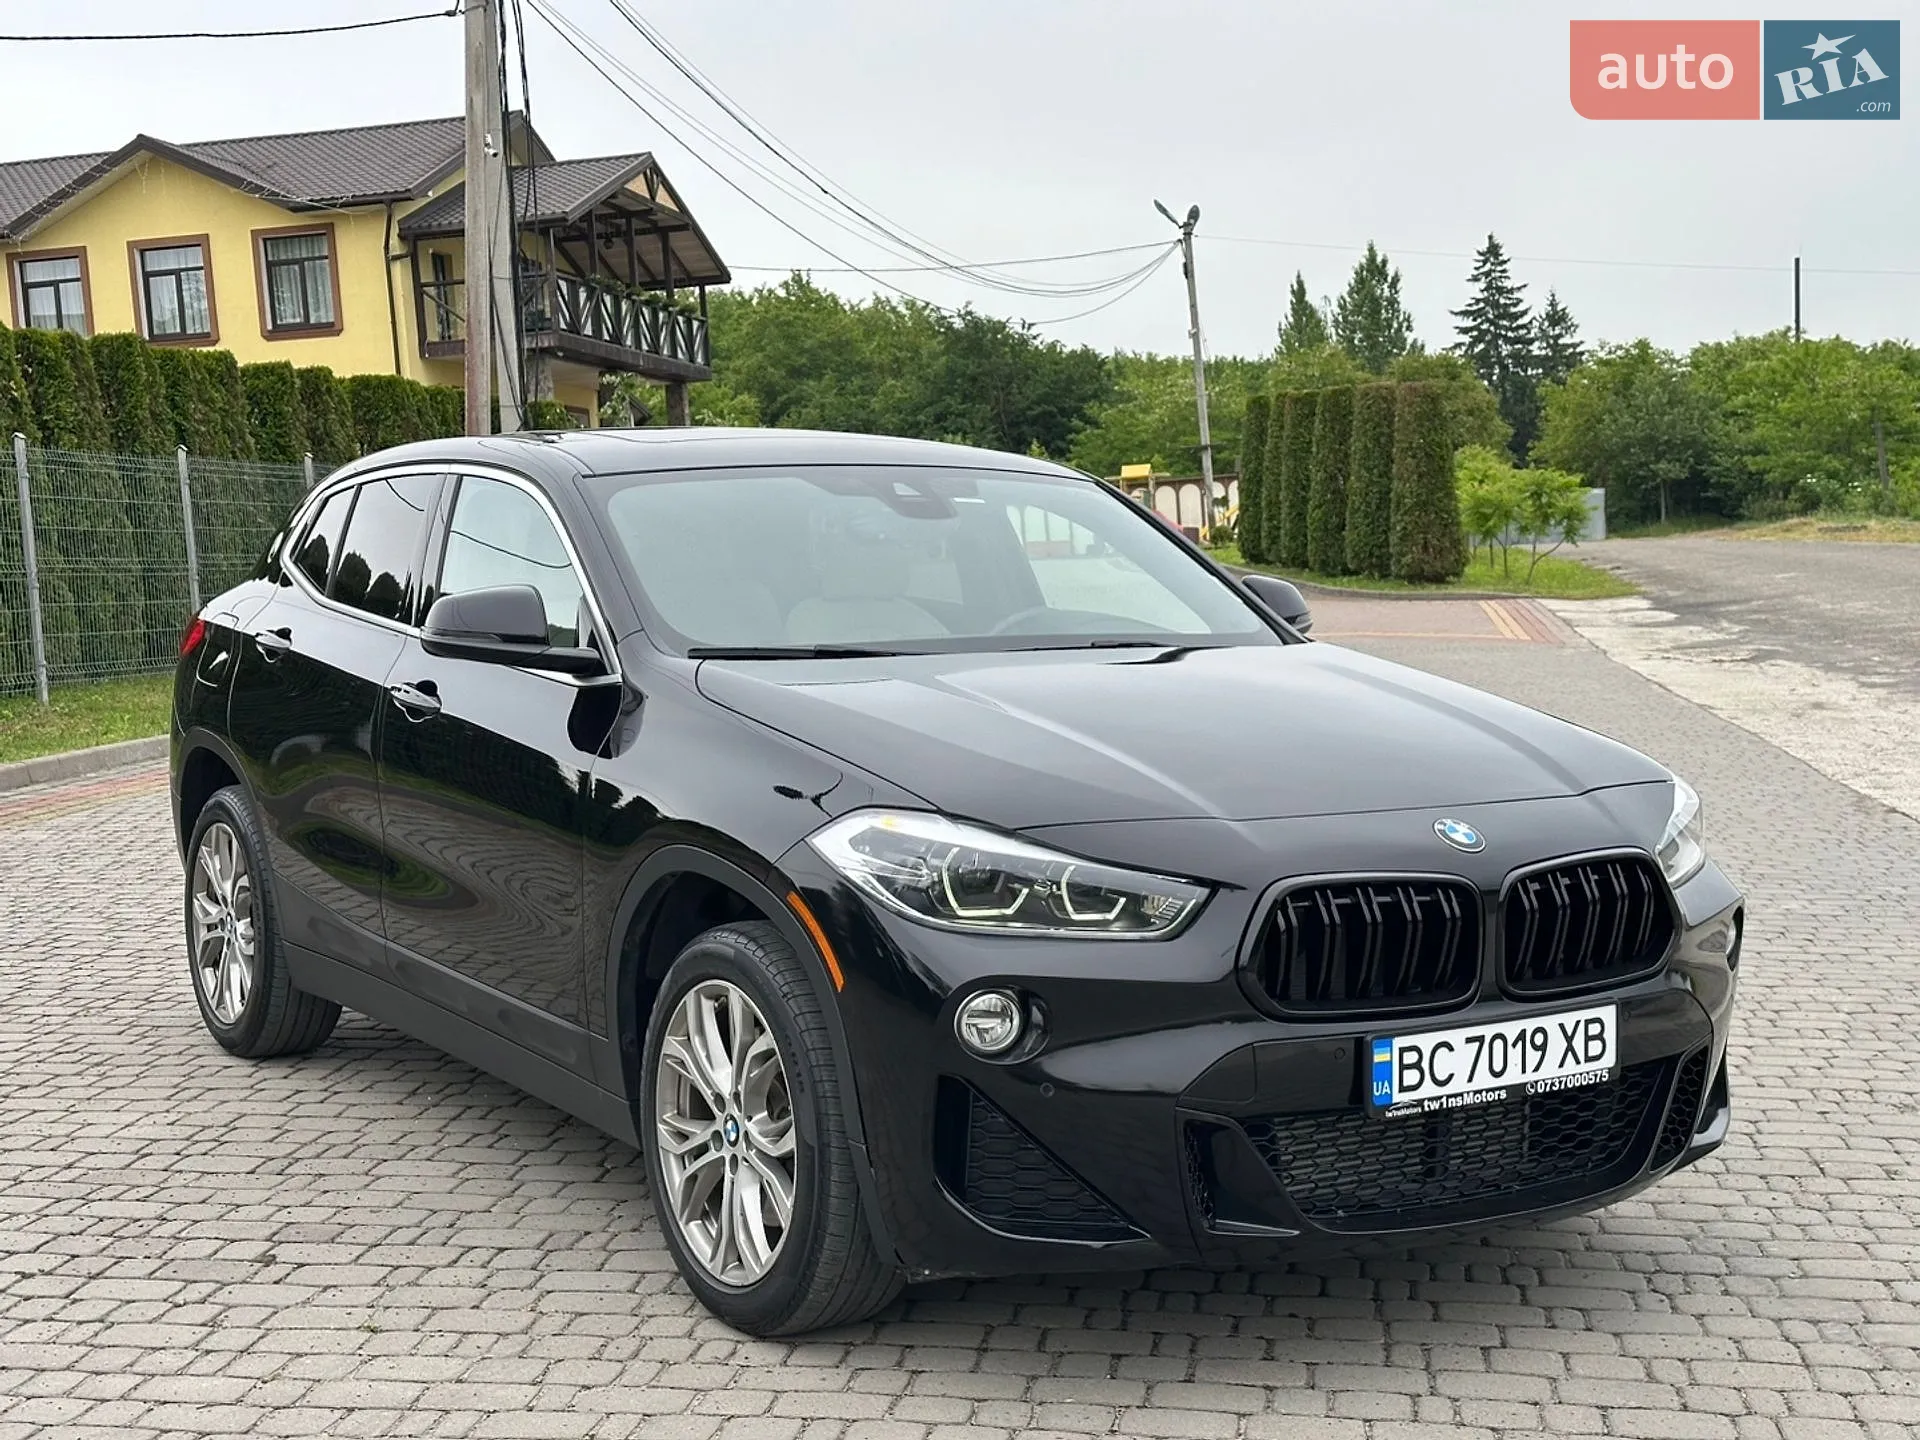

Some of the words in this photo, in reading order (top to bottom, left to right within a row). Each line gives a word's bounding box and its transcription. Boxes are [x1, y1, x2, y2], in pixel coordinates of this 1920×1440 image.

[1398, 1040, 1455, 1093] BC
[1464, 1026, 1549, 1083] 7019
[1558, 1017, 1606, 1069] XB
[1373, 1080, 1391, 1096] UA
[1536, 1069, 1609, 1093] 0737000575
